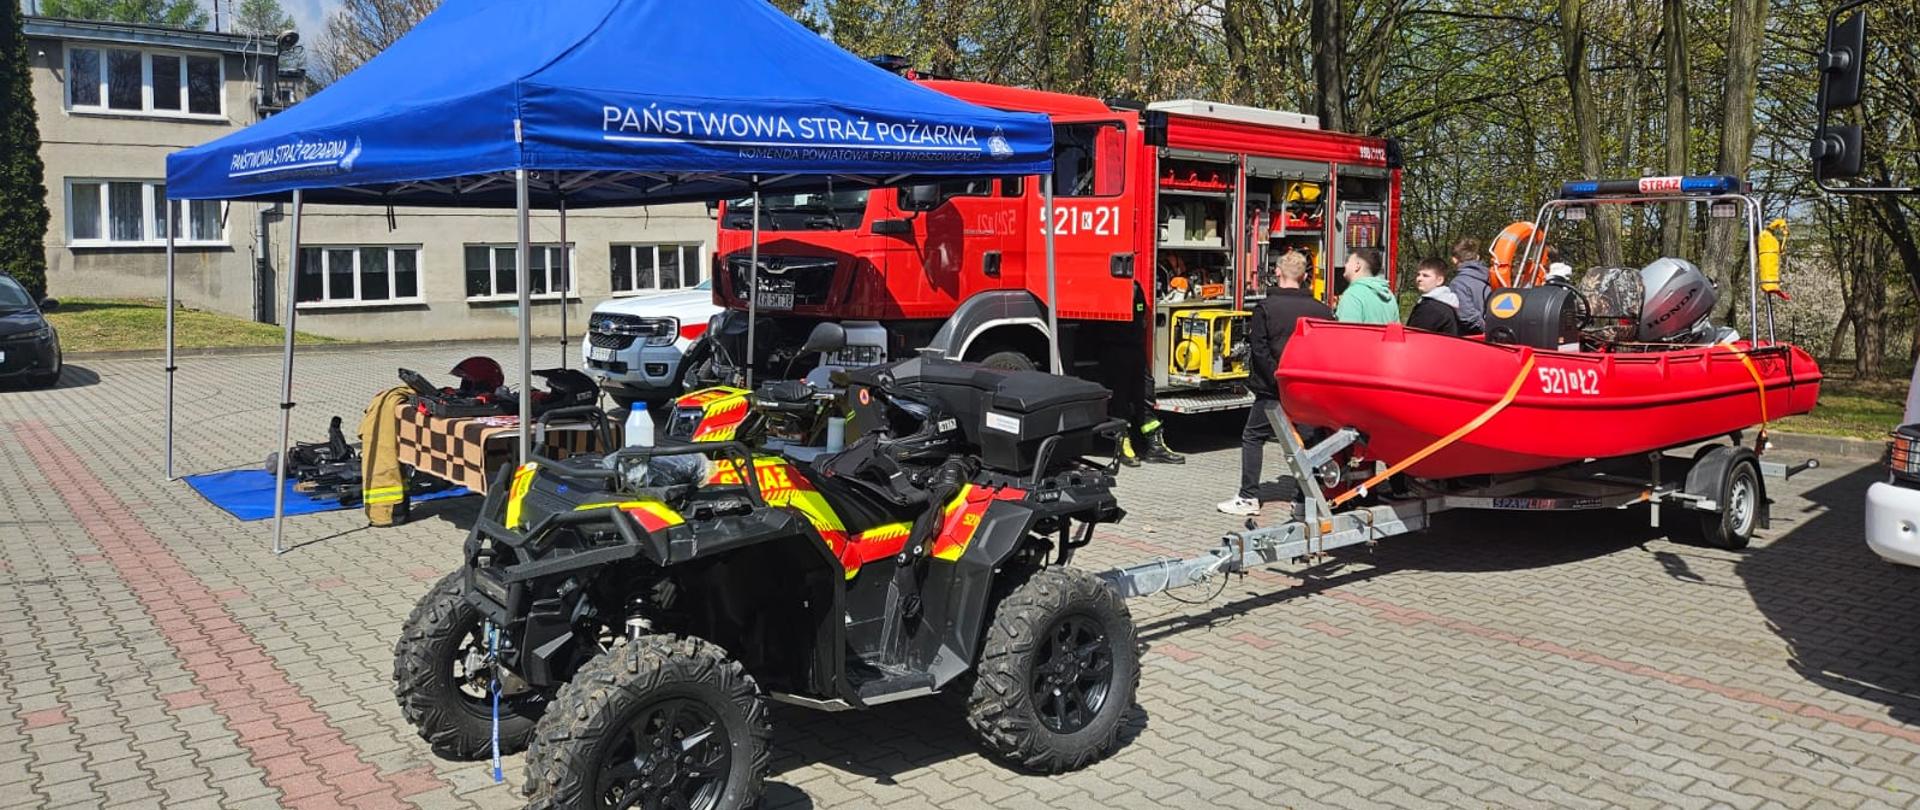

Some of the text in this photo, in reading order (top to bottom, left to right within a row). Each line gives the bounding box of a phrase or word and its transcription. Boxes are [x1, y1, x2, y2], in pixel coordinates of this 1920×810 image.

[603, 103, 978, 146] PAŃSTWOWA STRAŻ POŻARNA
[230, 138, 347, 171] PAŃSTWOWA STRAŻ POŻARNA
[739, 148, 799, 160] KOMENDA
[802, 149, 869, 161] POWIATOWA
[871, 151, 891, 161] PSP
[892, 151, 904, 161] W
[1647, 287, 1698, 328] HONDA
